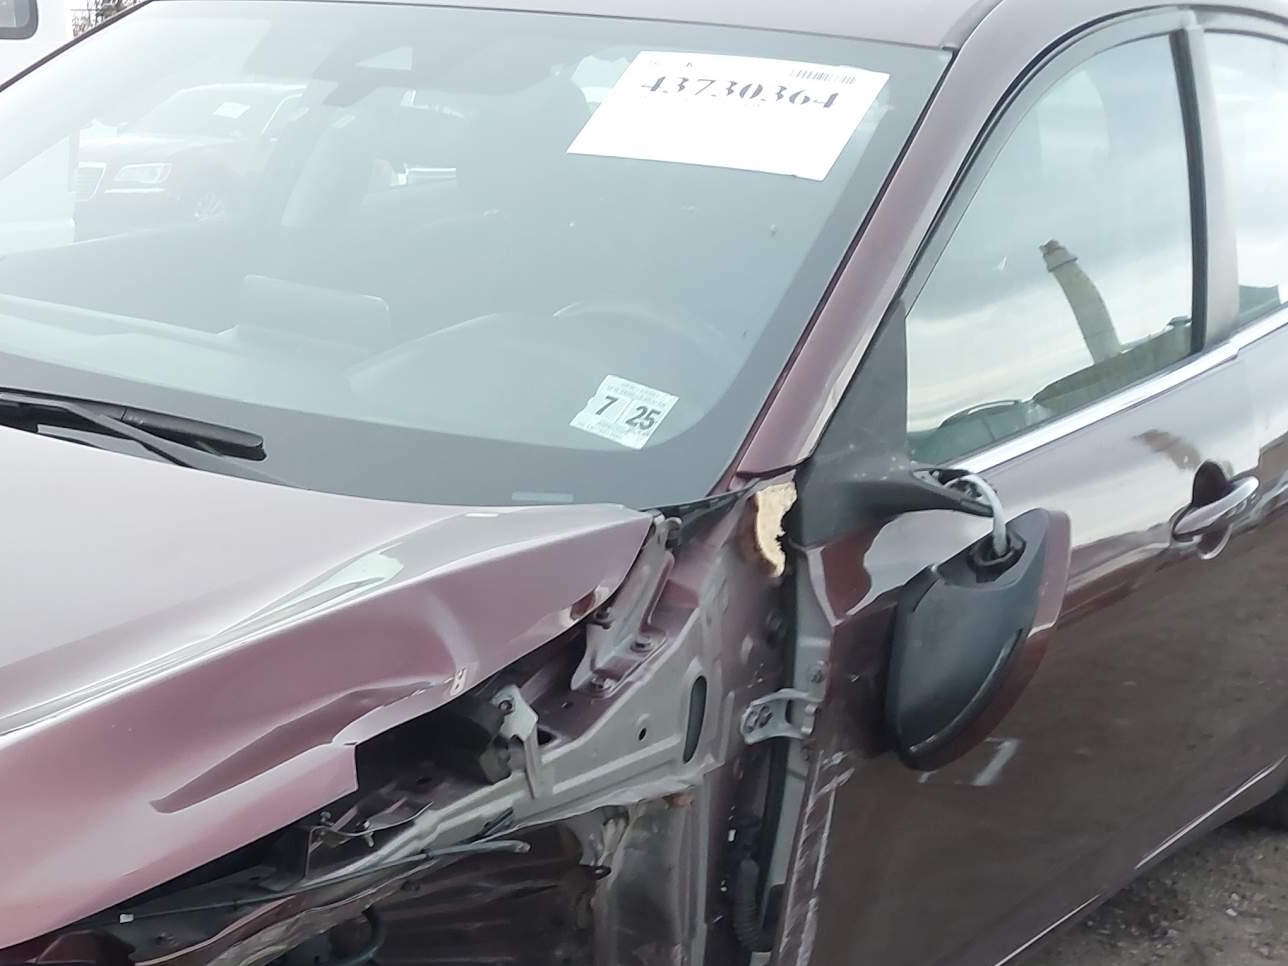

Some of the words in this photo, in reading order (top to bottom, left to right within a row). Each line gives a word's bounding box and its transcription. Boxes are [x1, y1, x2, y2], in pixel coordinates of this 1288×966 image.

[640, 74, 840, 110] 43730364
[595, 395, 619, 416] 7
[625, 405, 662, 430] 25
